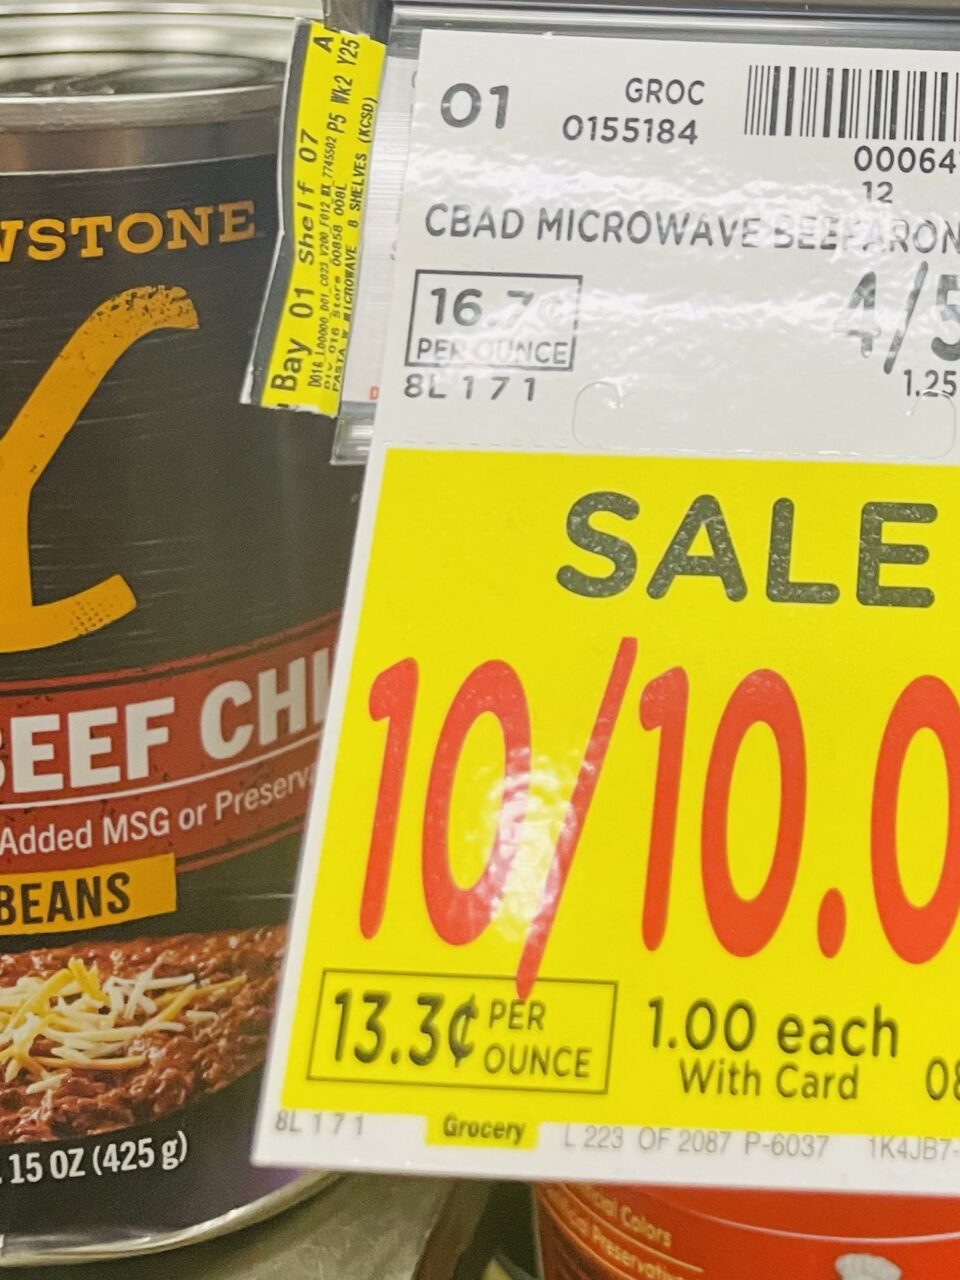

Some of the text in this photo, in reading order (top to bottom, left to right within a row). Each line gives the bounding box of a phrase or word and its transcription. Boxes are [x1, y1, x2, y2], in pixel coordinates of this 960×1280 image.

[326, 37, 361, 135] P5 Wk2 Y25
[440, 82, 510, 129] 01
[625, 77, 706, 106] GROC
[357, 97, 379, 144] (KCSD)
[562, 114, 699, 145] 0155184
[298, 128, 320, 163] 07
[349, 152, 368, 212] SHELVES
[862, 181, 894, 204] 12
[297, 179, 316, 266] Shelf
[332, 224, 344, 267] 00858
[425, 203, 525, 239] CBAD
[536, 206, 761, 248] MICROWAVE
[288, 287, 316, 320] 01
[329, 275, 341, 319] Store
[343, 245, 358, 322] MICROWAVE
[270, 337, 314, 392] Bay
[332, 348, 347, 393] PASTA
[903, 369, 958, 398] 1.25
[555, 490, 939, 609] SALE
[0, 696, 176, 795] EEF
[0, 820, 93, 856] Added
[103, 806, 171, 847] MSG
[178, 803, 207, 832] or
[0, 870, 131, 926] BEANS
[333, 987, 547, 1068] 13.3¢ PER
[648, 995, 757, 1053] 1.00
[777, 1003, 899, 1058] each
[483, 1042, 595, 1079] OUNCE
[679, 1057, 762, 1098] With
[775, 1060, 860, 1101] Card
[9, 1130, 188, 1185] 15 OZ (425 g)
[443, 1112, 526, 1146] Grocery
[583, 1125, 625, 1149] 223
[637, 1126, 672, 1151] OF
[678, 1128, 733, 1154] 2087
[744, 1131, 830, 1158] P-6037
